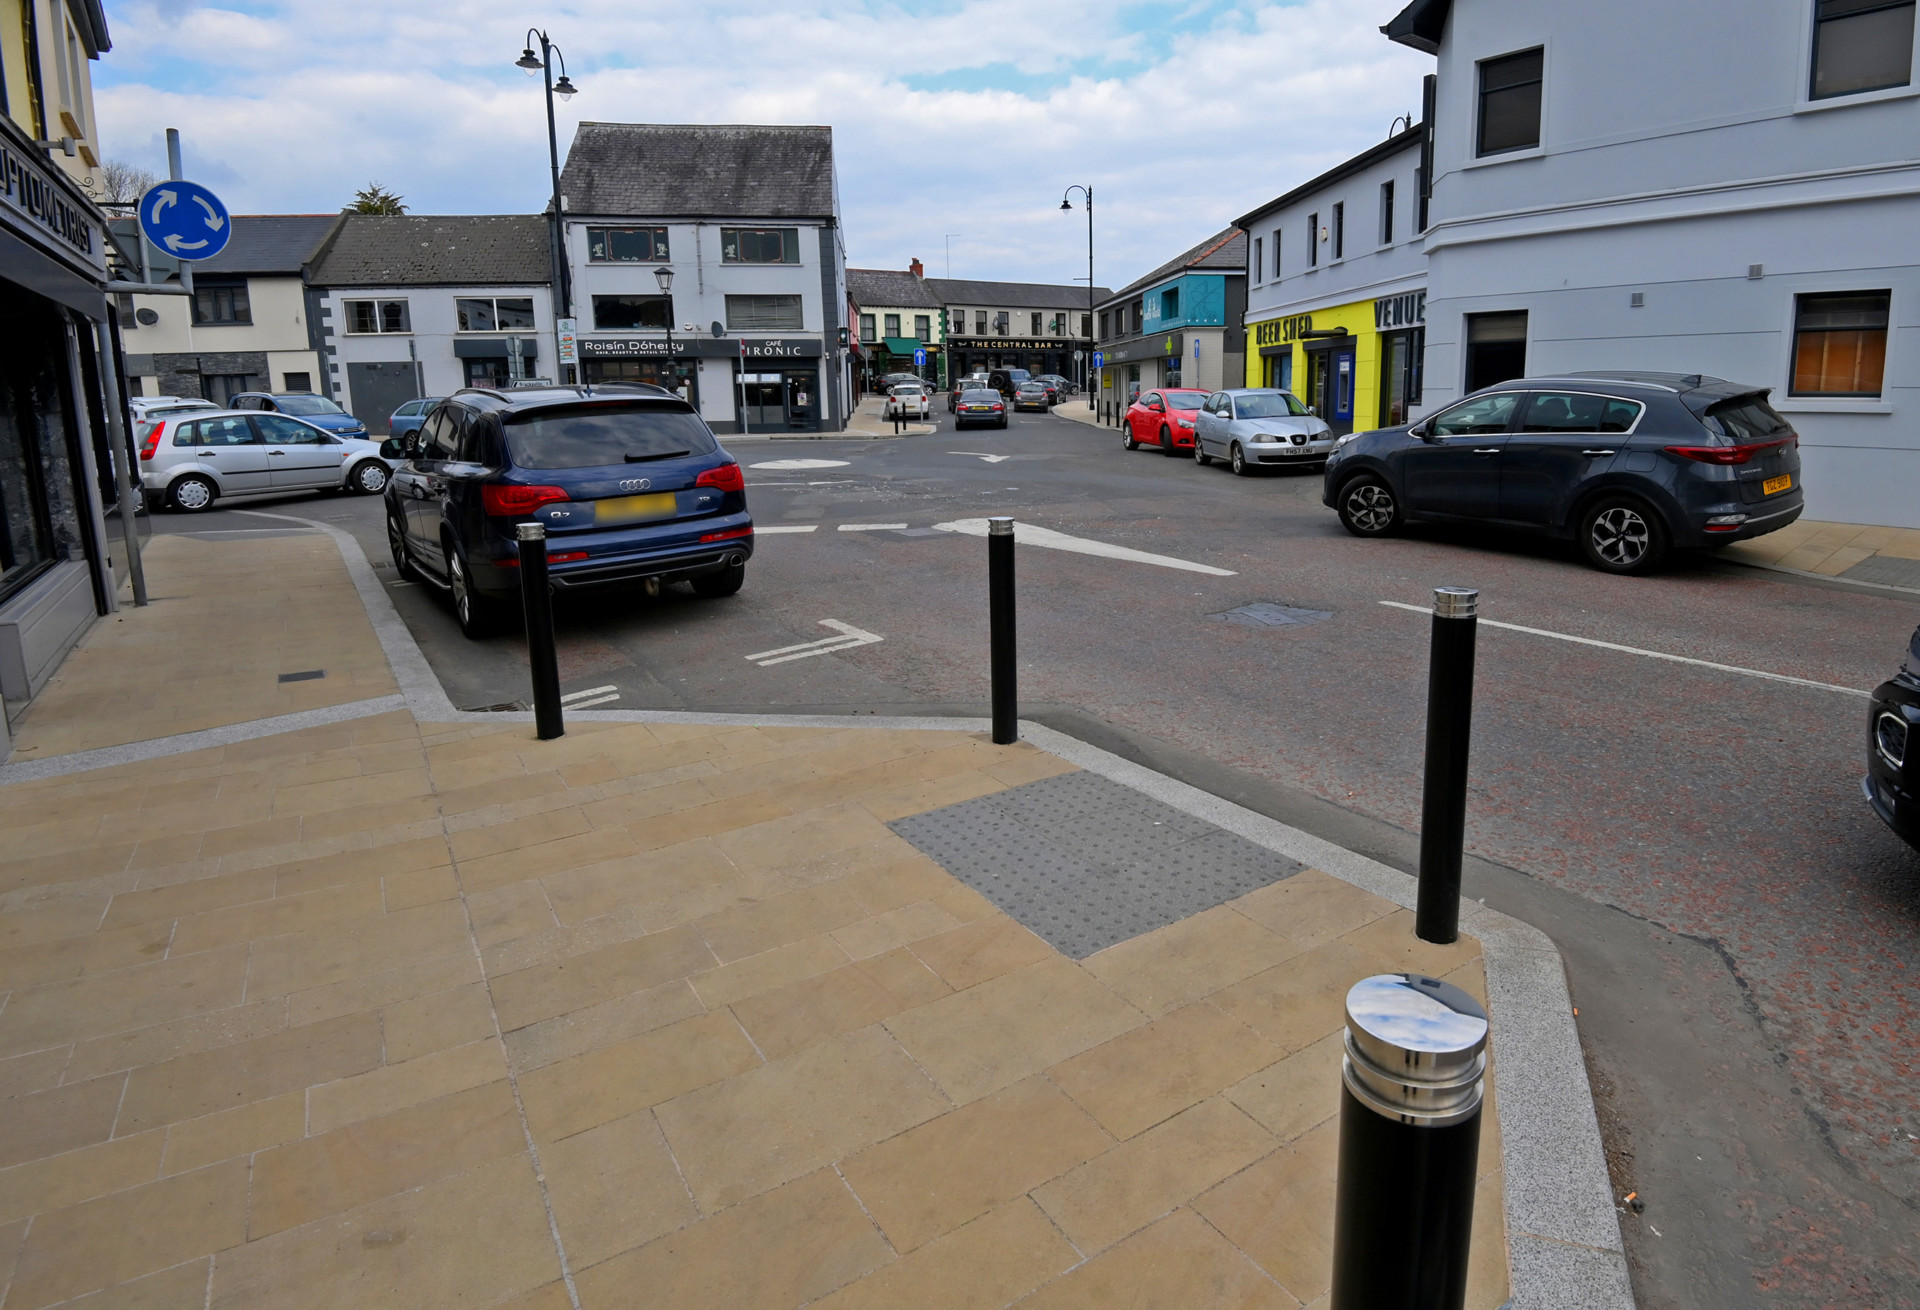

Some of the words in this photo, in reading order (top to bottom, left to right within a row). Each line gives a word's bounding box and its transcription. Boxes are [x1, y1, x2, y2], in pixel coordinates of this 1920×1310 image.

[1373, 292, 1427, 328] VENUE
[1256, 321, 1281, 345] BEER
[1282, 315, 1313, 342] SHED
[584, 341, 625, 351] Roisín
[991, 341, 1033, 349] CENTRAL
[1034, 341, 1052, 349] BAR
[746, 346, 801, 356] IRONIC
[550, 511, 570, 519] Q7
